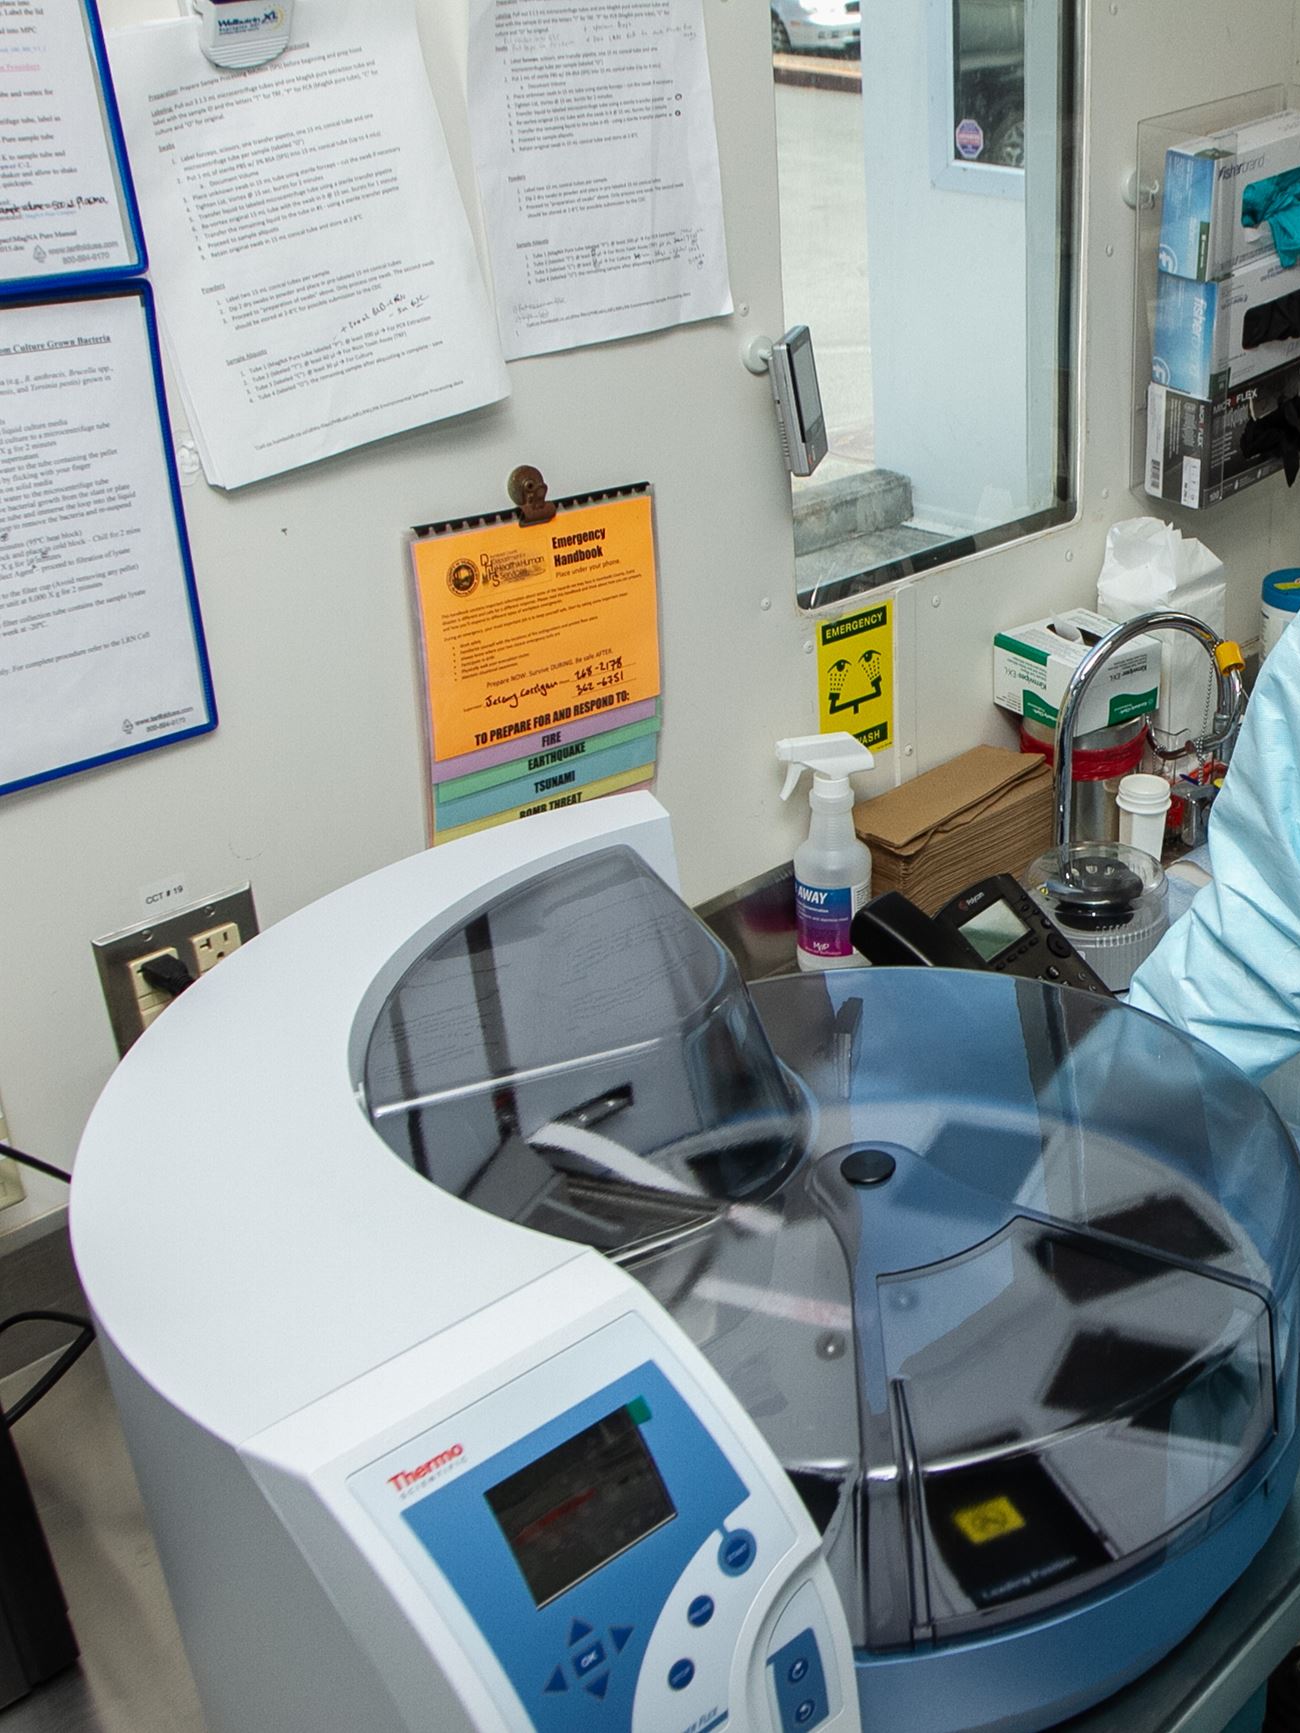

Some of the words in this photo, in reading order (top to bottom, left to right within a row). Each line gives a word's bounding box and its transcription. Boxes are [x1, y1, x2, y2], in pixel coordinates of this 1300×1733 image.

[13, 343, 44, 352] Culture
[47, 339, 74, 348] Grown
[77, 334, 111, 345] Bacteria
[552, 528, 606, 550] Emergency
[554, 545, 603, 567] Handbook
[555, 569, 570, 578] Place
[572, 566, 588, 576] under
[588, 564, 600, 574] your
[826, 612, 883, 640] EMERGENCY
[486, 676, 509, 688] Prepare
[528, 668, 549, 678] Survive
[584, 653, 595, 664] safe
[474, 732, 488, 746] TO
[490, 718, 532, 742] PREPARE
[534, 712, 550, 730] FOR
[552, 706, 572, 724] AND
[574, 694, 615, 718] RESPOND
[616, 689, 630, 705] TO:
[542, 731, 562, 748] FIRE
[528, 742, 586, 771] EARTHQUAKE
[534, 770, 576, 794] TSUNAMI
[548, 792, 582, 810] THREAT
[145, 892, 164, 905] CCT
[173, 885, 184, 895] 19
[798, 886, 828, 904] AWAY
[386, 1444, 464, 1492] Thermo
[580, 1650, 598, 1668] OK
